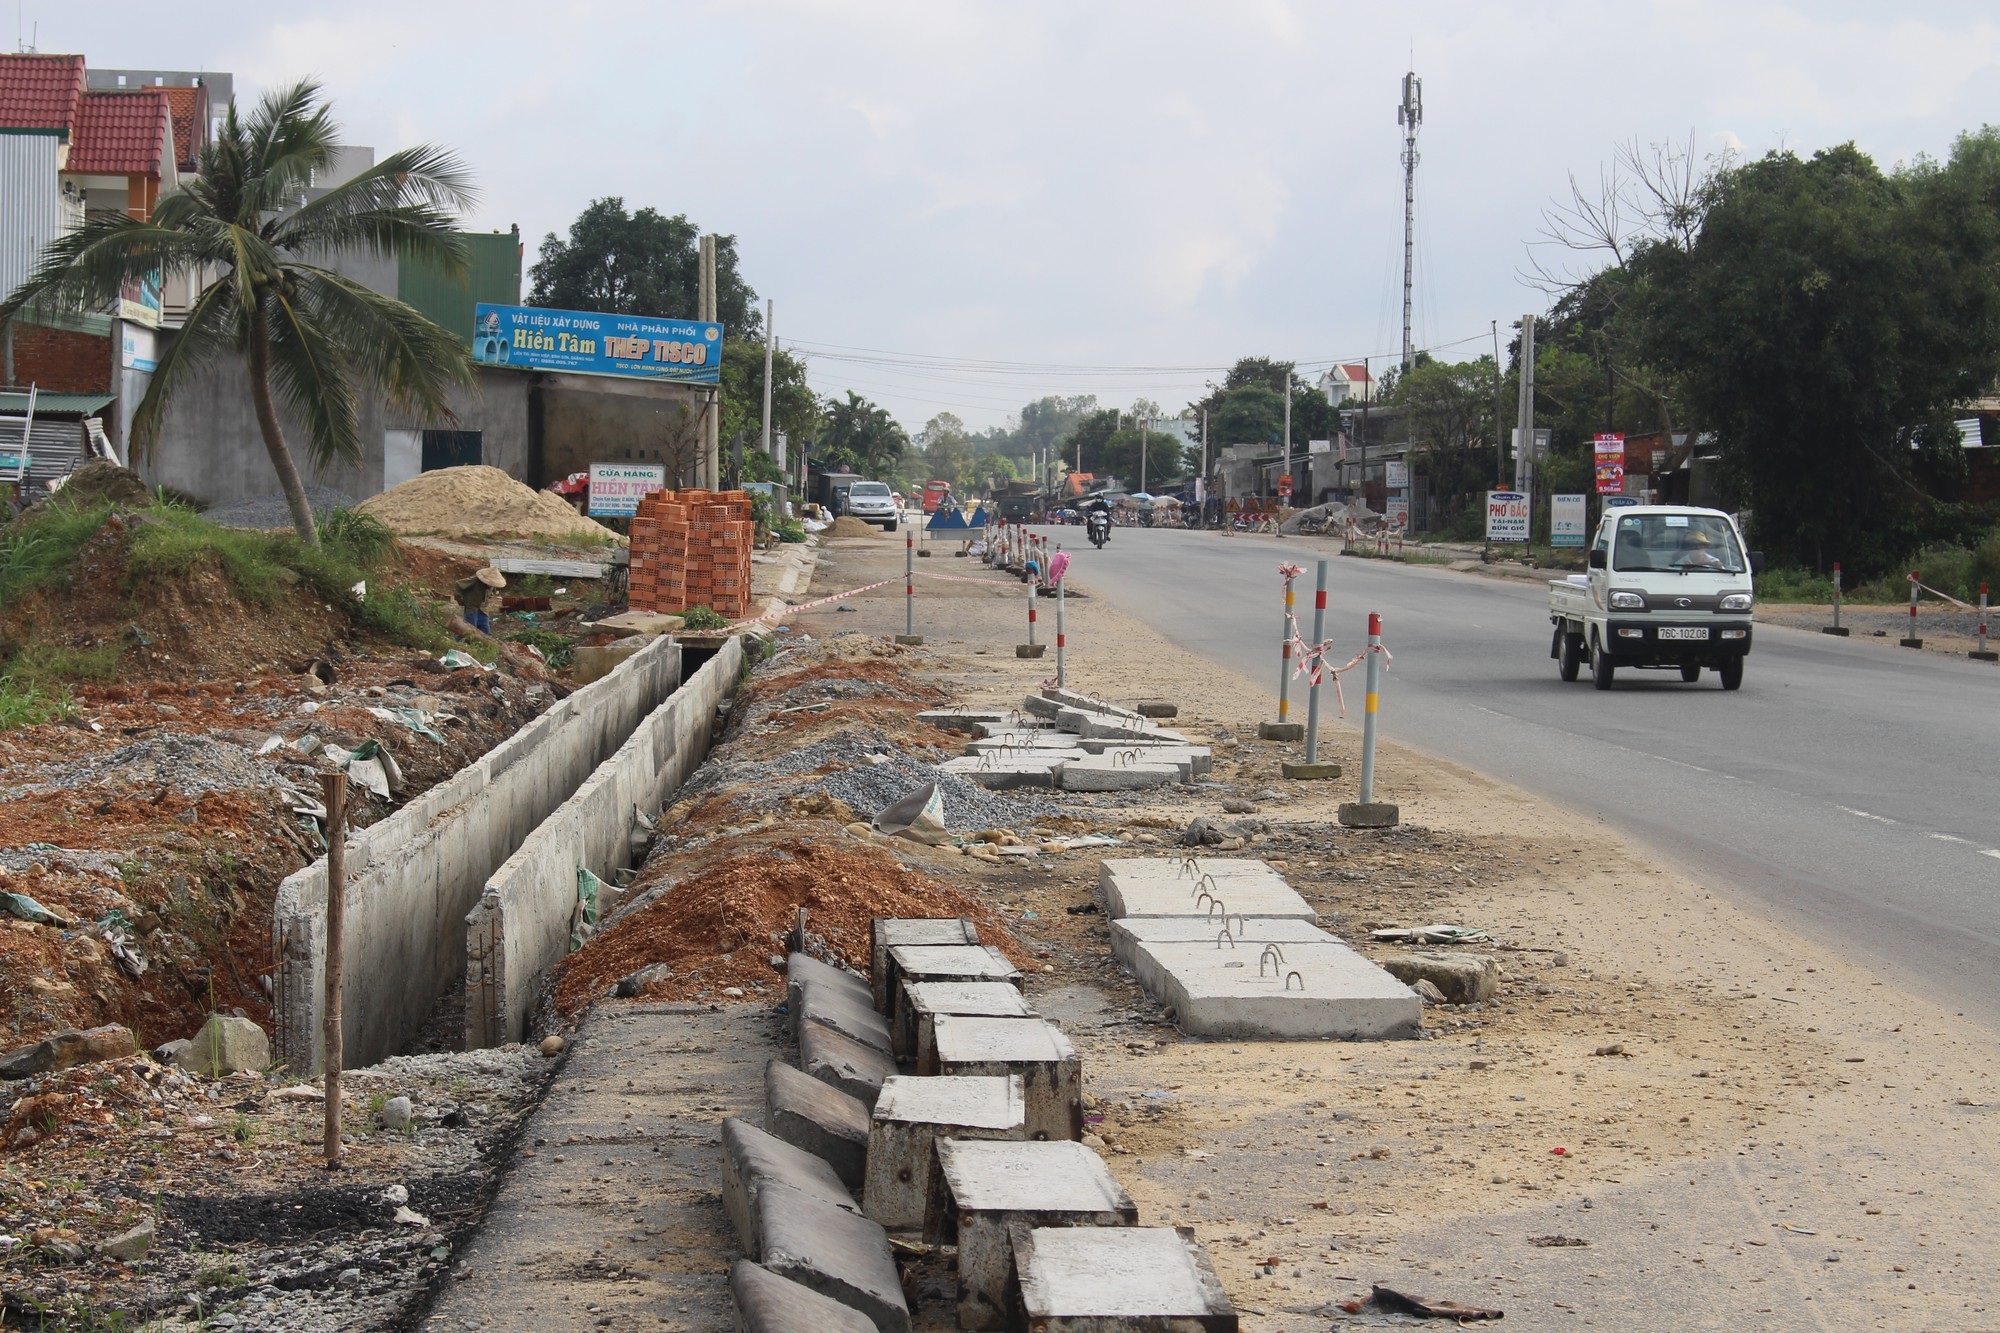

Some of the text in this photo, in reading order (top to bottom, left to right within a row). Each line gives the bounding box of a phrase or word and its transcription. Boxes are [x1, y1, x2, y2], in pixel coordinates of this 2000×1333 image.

[512, 312, 600, 331] VẬT LIỆU XÂY DỰNG
[618, 323, 696, 336] NHÀ PHÂN PHỐI
[512, 328, 596, 354] Hiền Tâm
[604, 334, 707, 365] THÉP TISCO
[592, 478, 628, 495] HIỀN
[1490, 500, 1528, 517] PHỞ BẮC
[1660, 629, 1708, 639] 76C-102.08
